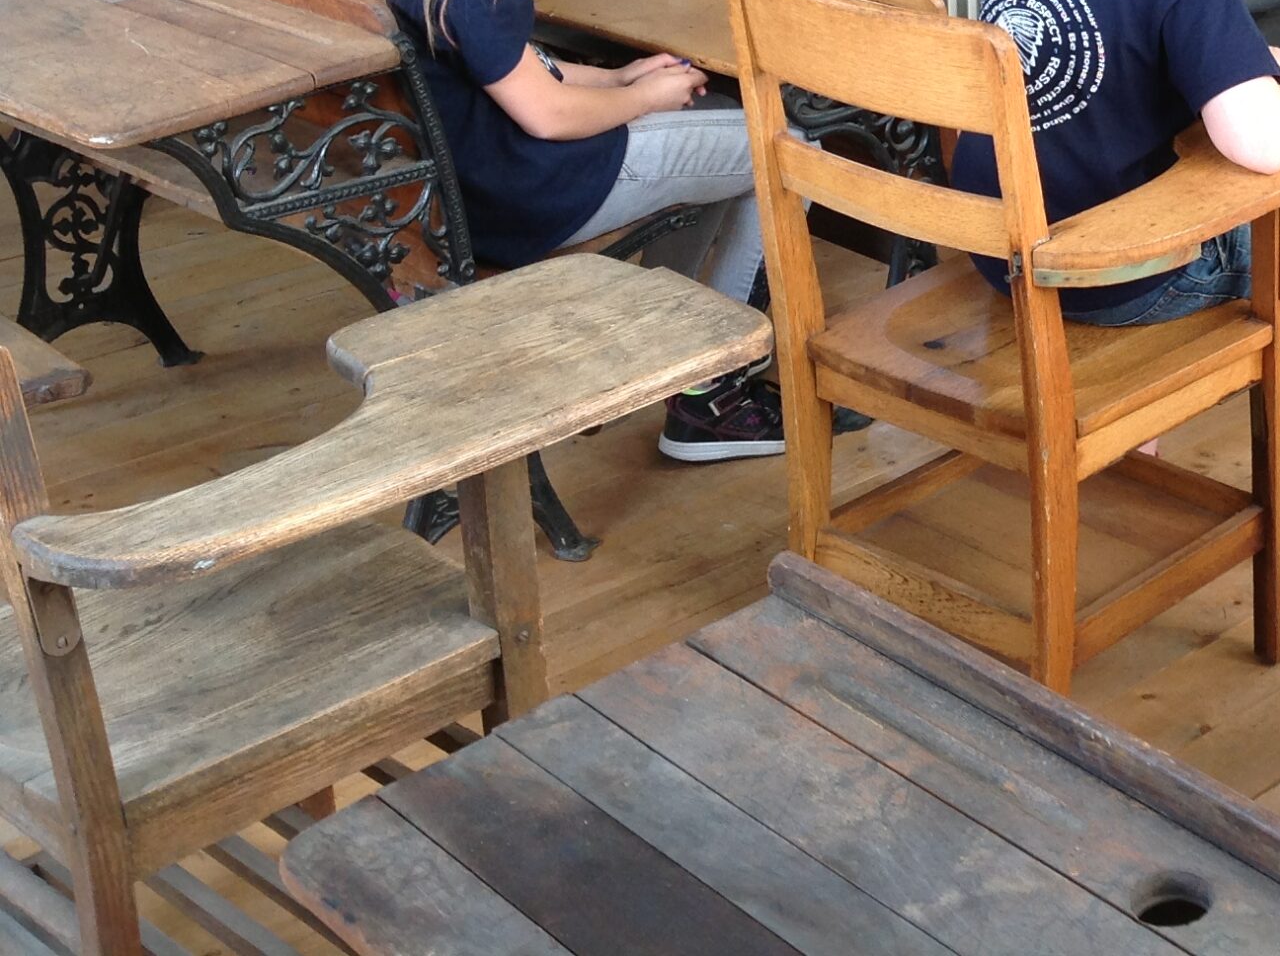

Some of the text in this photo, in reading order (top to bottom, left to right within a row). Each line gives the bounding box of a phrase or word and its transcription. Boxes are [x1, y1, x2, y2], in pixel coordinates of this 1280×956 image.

[1067, 31, 1077, 51] Be
[1089, 31, 1106, 94] manners
[1025, 55, 1061, 96] RESPE
[1037, 53, 1077, 107] respectful
